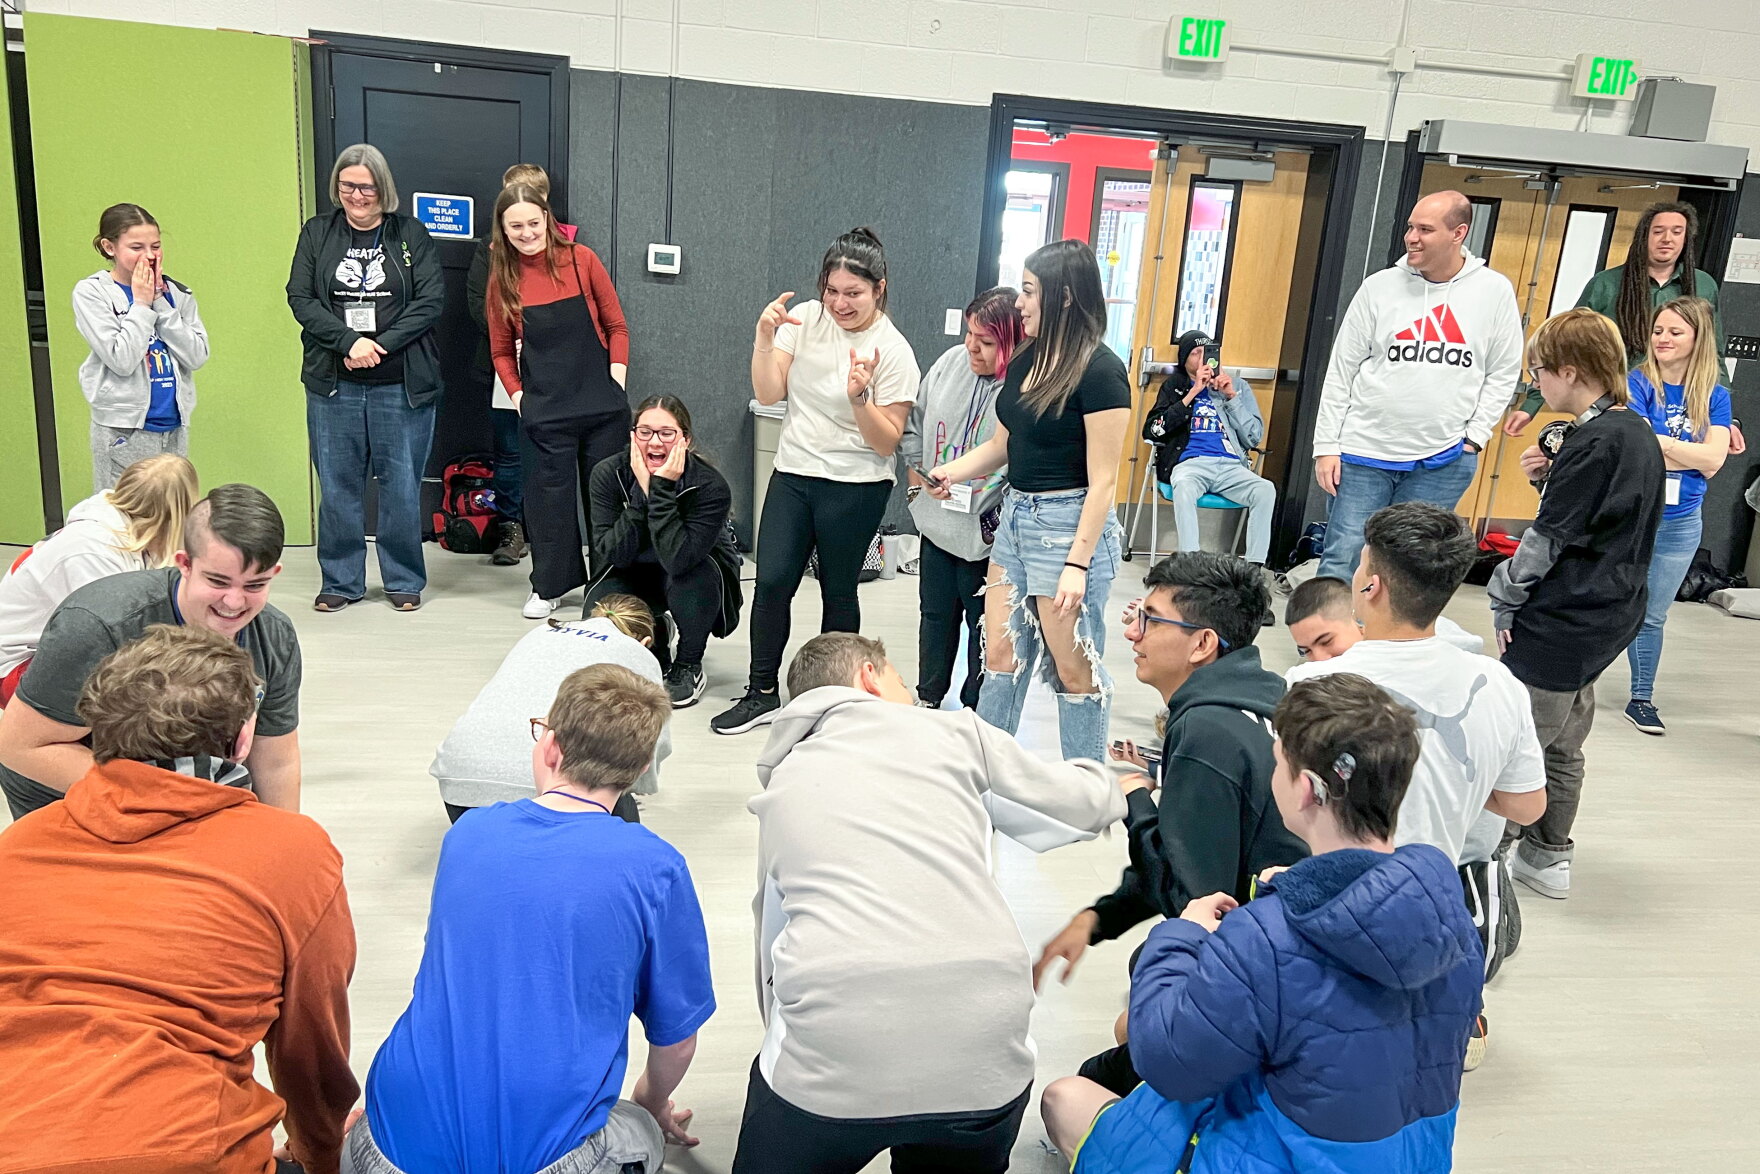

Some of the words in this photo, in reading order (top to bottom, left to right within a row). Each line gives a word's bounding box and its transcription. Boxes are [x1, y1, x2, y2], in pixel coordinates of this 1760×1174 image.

[1179, 17, 1226, 58] EXIT
[1587, 56, 1634, 96] EXIT
[428, 206, 440, 215] THIS
[441, 208, 459, 216] PLACE
[434, 215, 453, 223] CLEAN
[437, 223, 463, 231] ORDERLY
[1387, 340, 1473, 368] adidas
